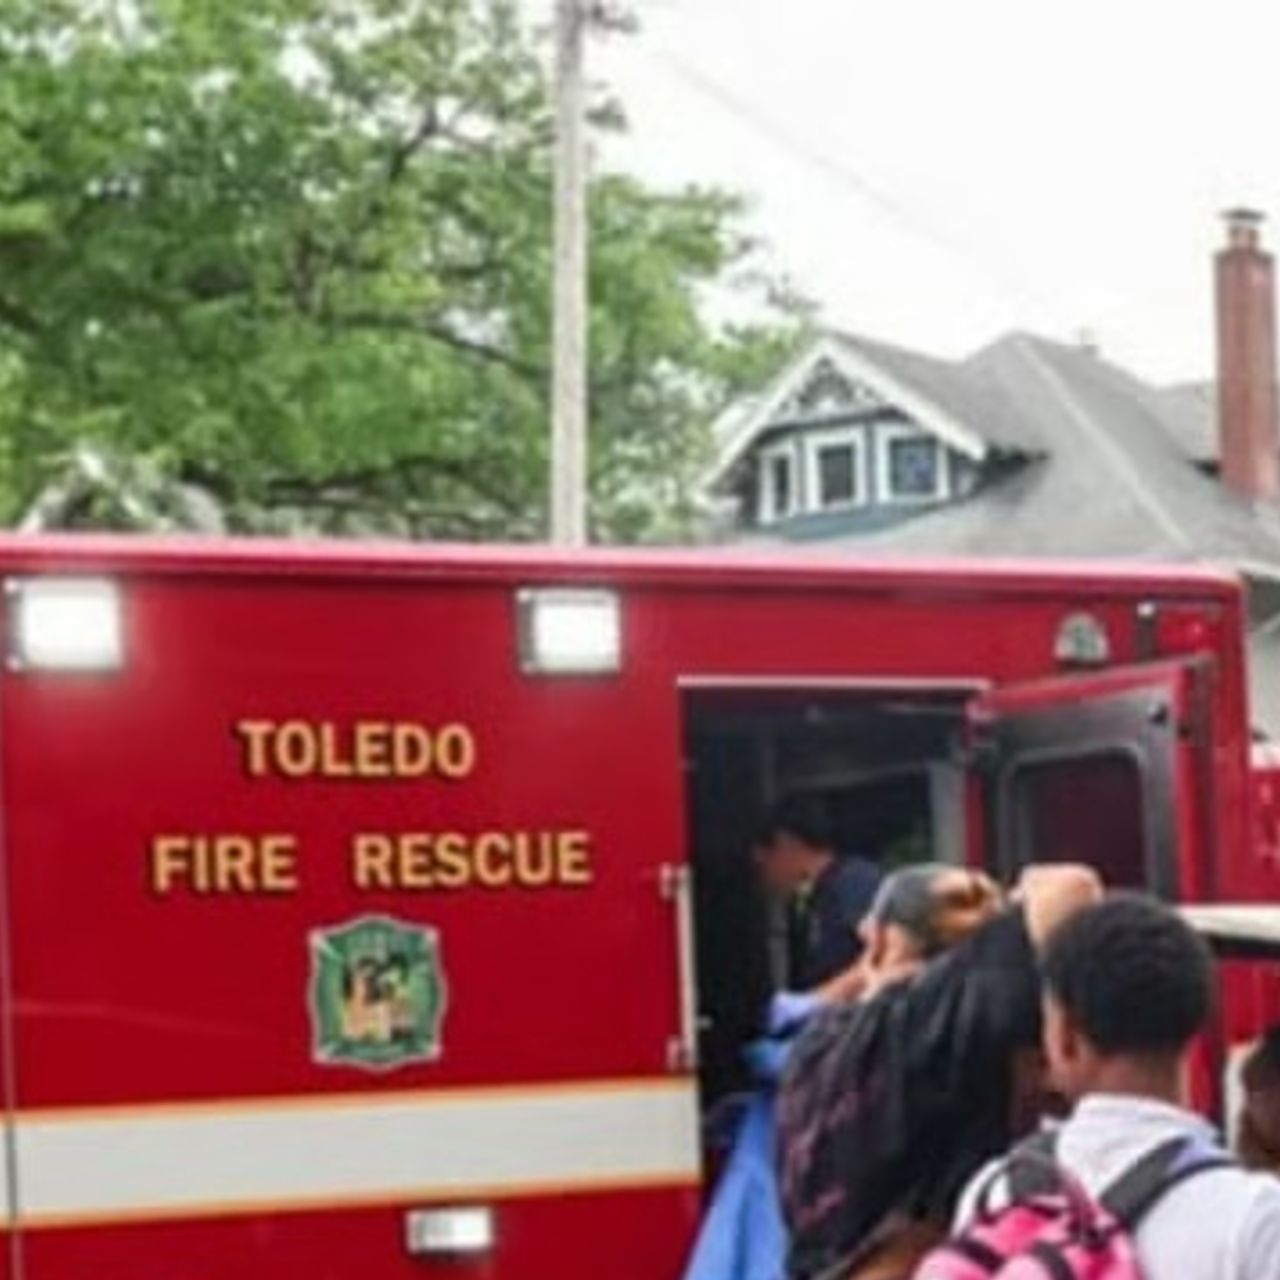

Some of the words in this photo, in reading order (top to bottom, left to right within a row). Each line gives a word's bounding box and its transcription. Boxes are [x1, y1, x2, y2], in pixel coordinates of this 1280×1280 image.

[237, 719, 476, 778] TOLEDO
[152, 834, 299, 893] FIRE
[352, 830, 593, 888] RESCUE
